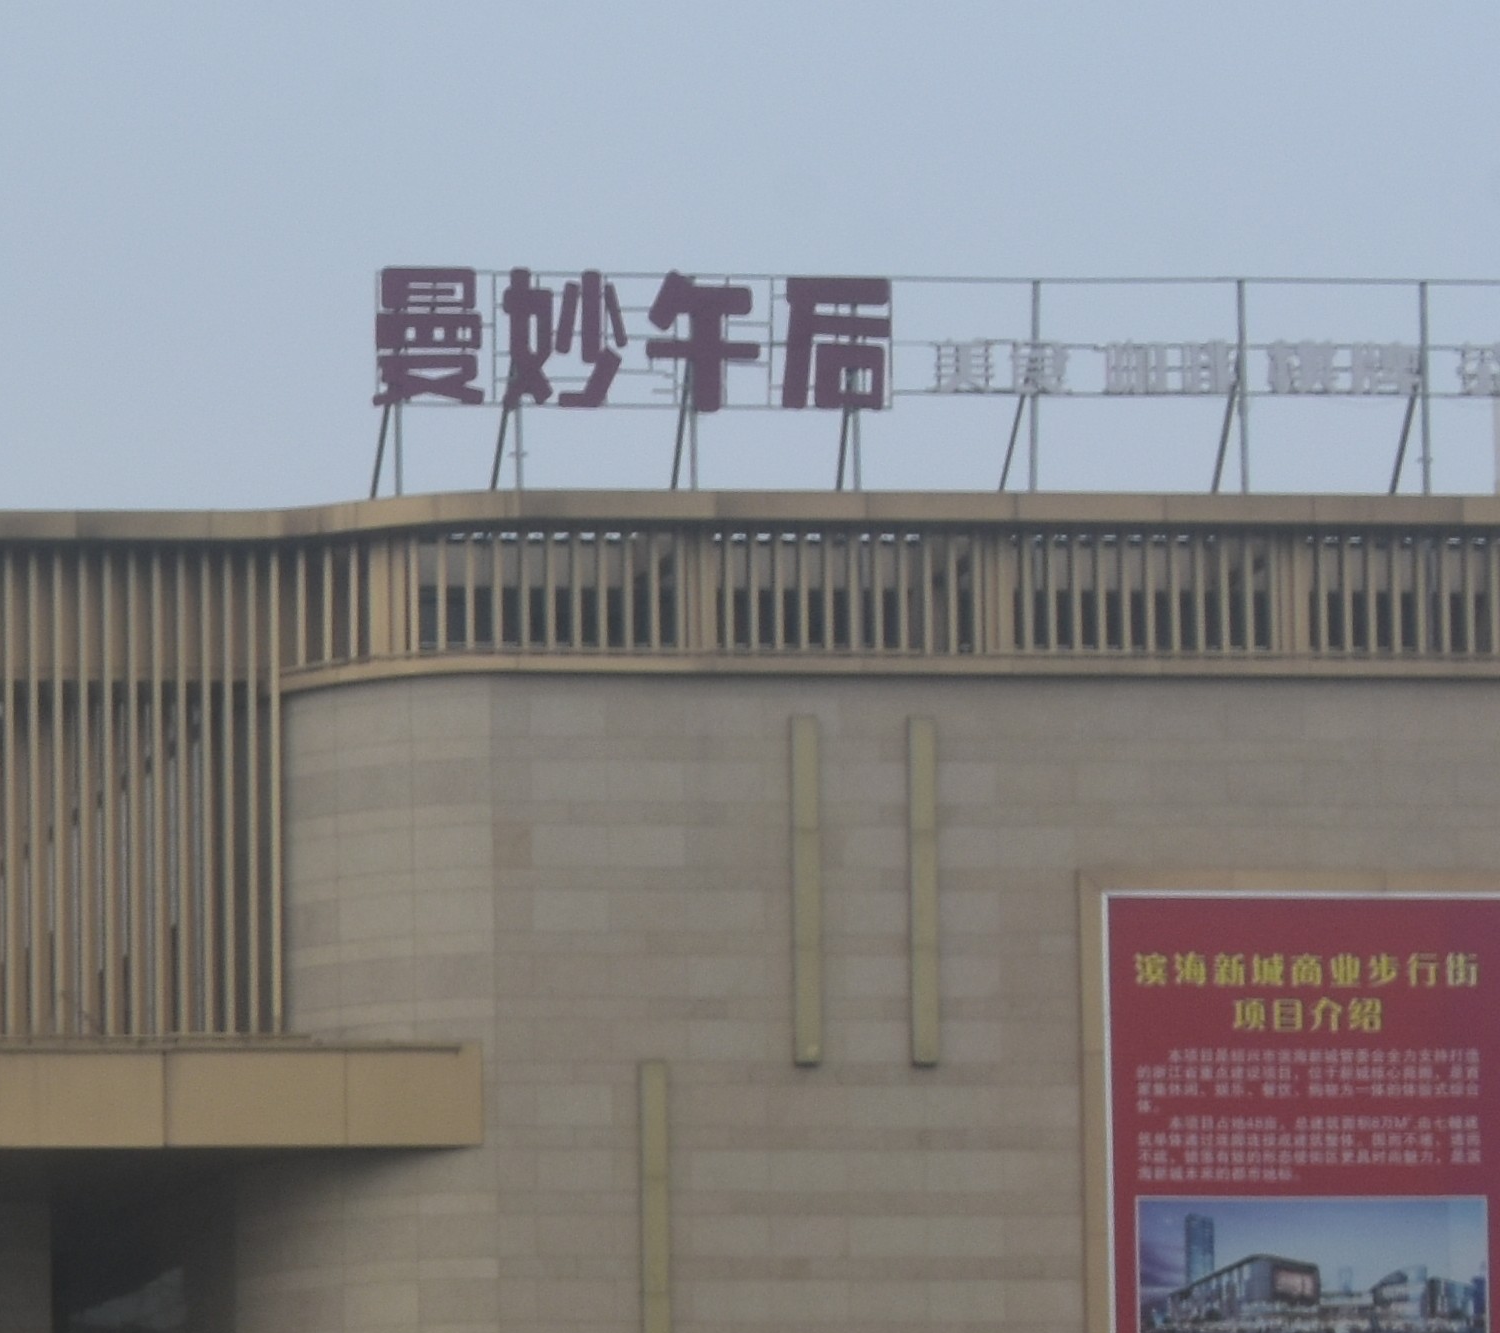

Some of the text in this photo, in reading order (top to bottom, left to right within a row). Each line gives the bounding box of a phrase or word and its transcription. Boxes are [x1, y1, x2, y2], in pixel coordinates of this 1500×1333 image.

[372, 265, 893, 412] 曼妙午后
[1133, 951, 1480, 988] 滨海新城商业步行街
[1233, 996, 1383, 1033] 项目介绍
